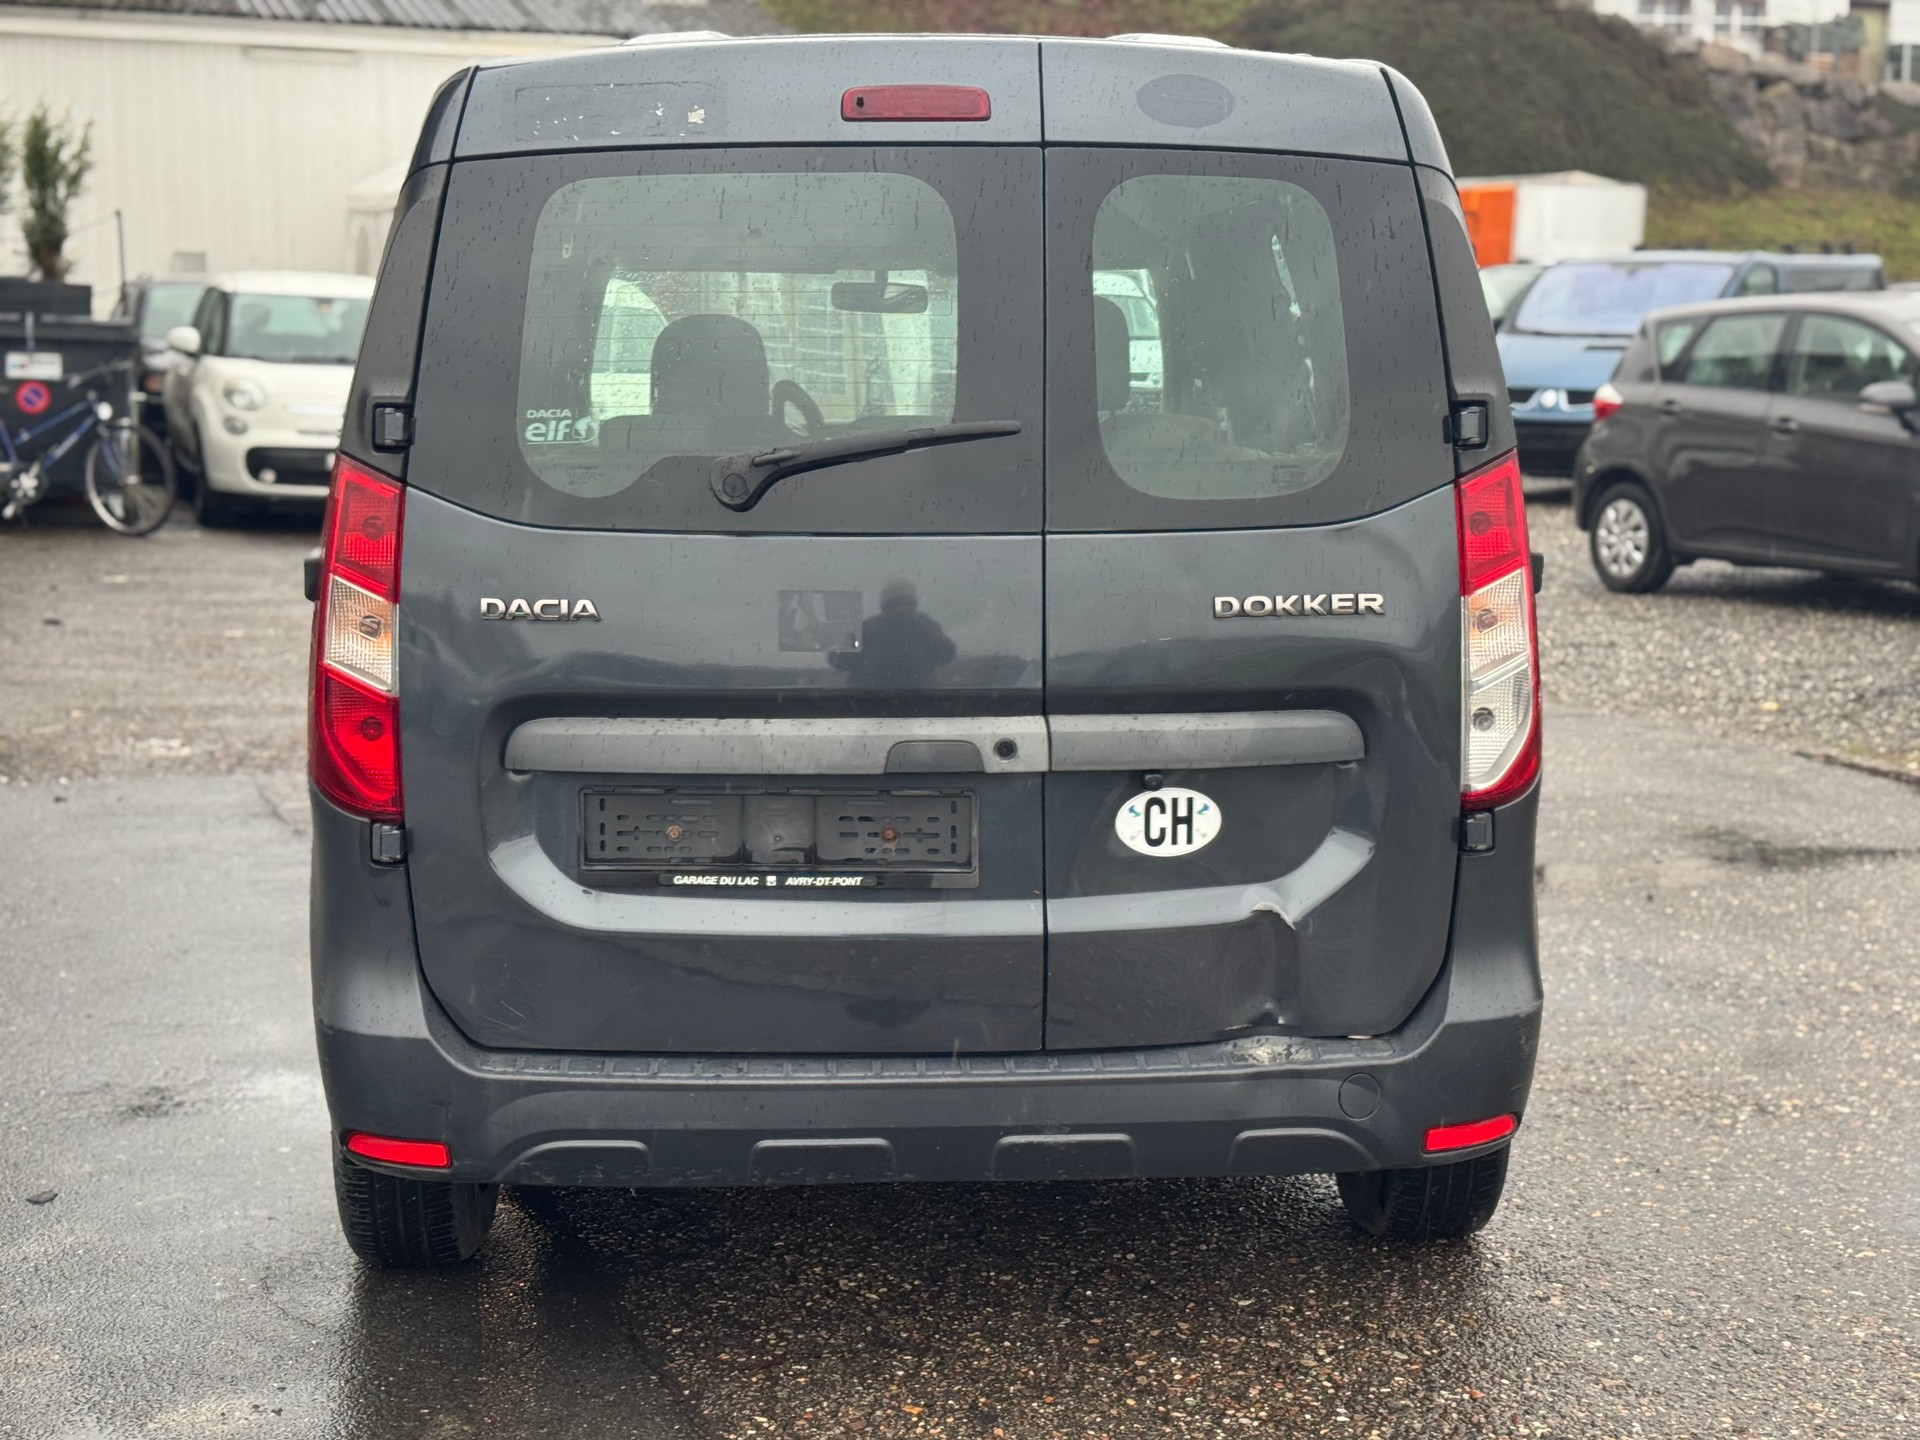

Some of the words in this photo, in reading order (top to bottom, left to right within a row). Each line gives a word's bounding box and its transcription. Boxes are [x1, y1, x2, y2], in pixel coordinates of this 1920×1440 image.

[526, 408, 572, 418] DACIA
[525, 419, 572, 441] elf
[480, 597, 601, 620] DACIA
[1214, 593, 1385, 618] DOKKER
[1144, 796, 1194, 847] CH
[673, 875, 718, 885] GARAGE
[719, 876, 737, 885] DU
[737, 876, 759, 885] LAC
[785, 876, 863, 886] AVRY-DT-PONT
